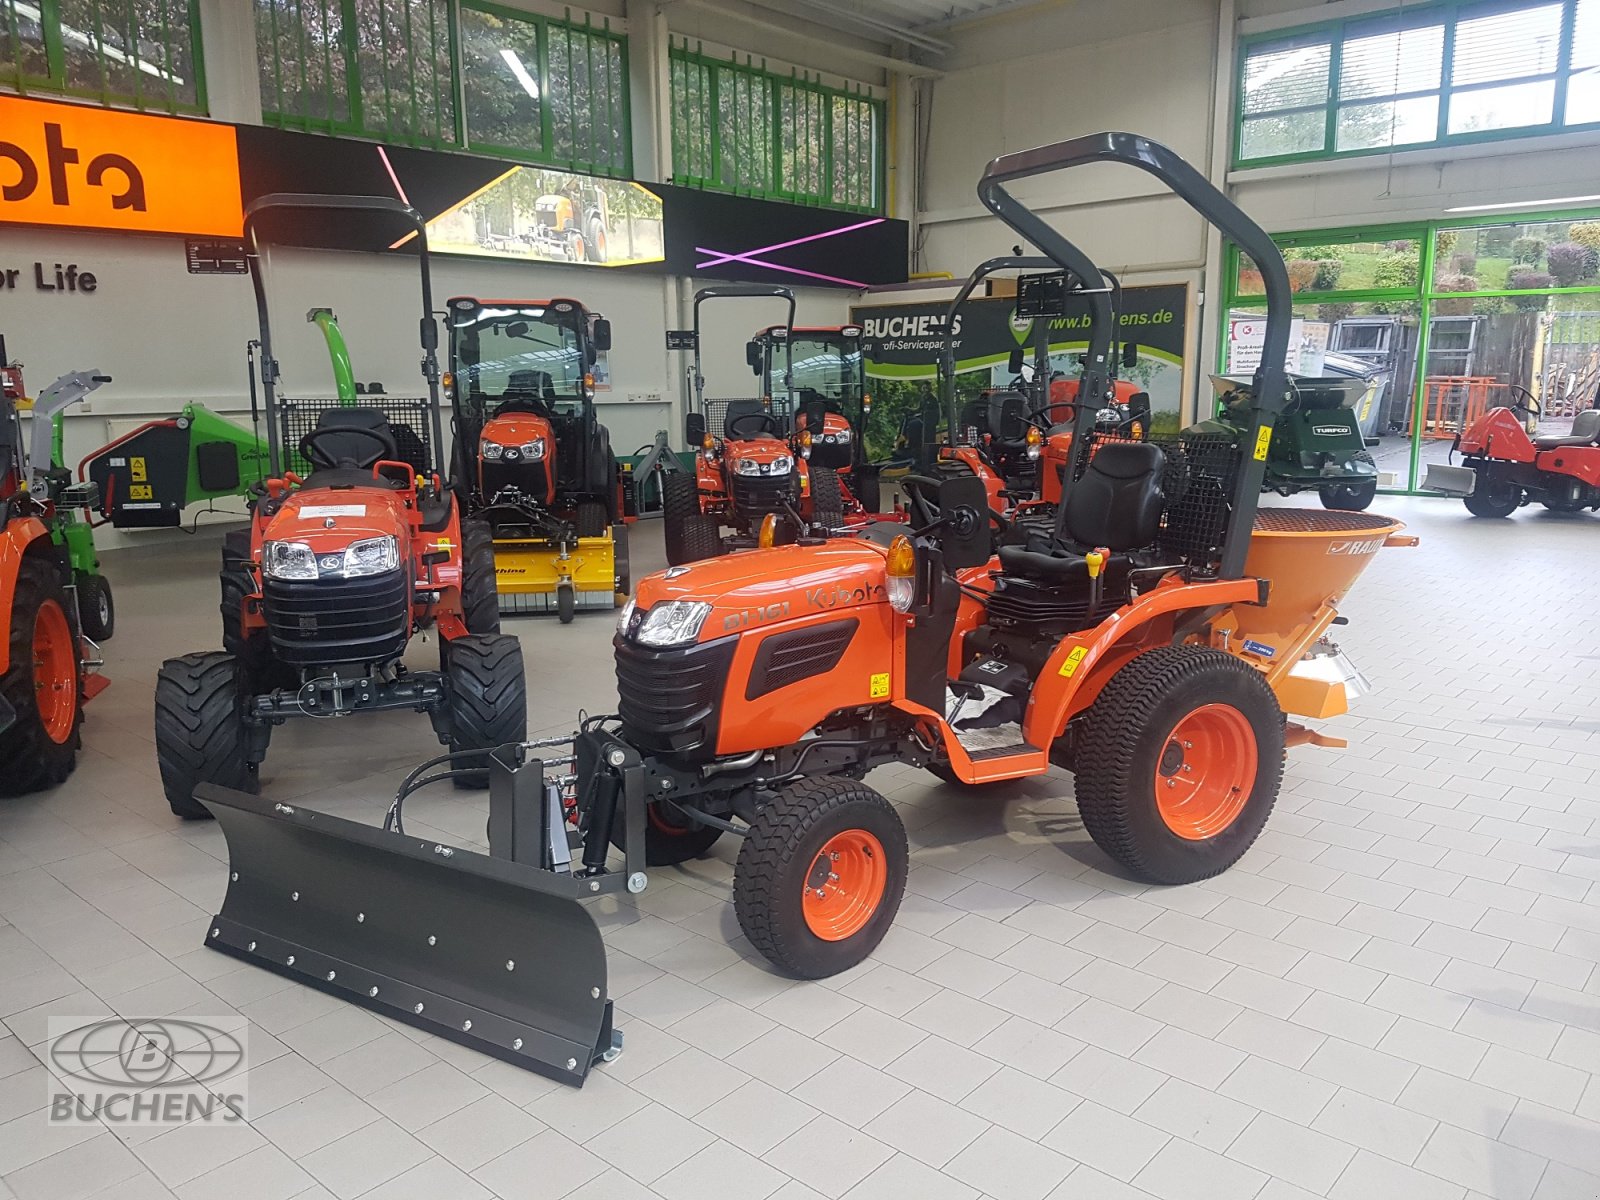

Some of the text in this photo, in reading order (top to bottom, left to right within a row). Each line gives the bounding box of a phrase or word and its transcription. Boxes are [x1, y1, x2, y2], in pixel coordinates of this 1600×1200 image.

[35, 262, 97, 291] Life
[864, 314, 962, 338] BUCHENS
[805, 580, 888, 608] Kubota
[723, 601, 791, 632] B1-161
